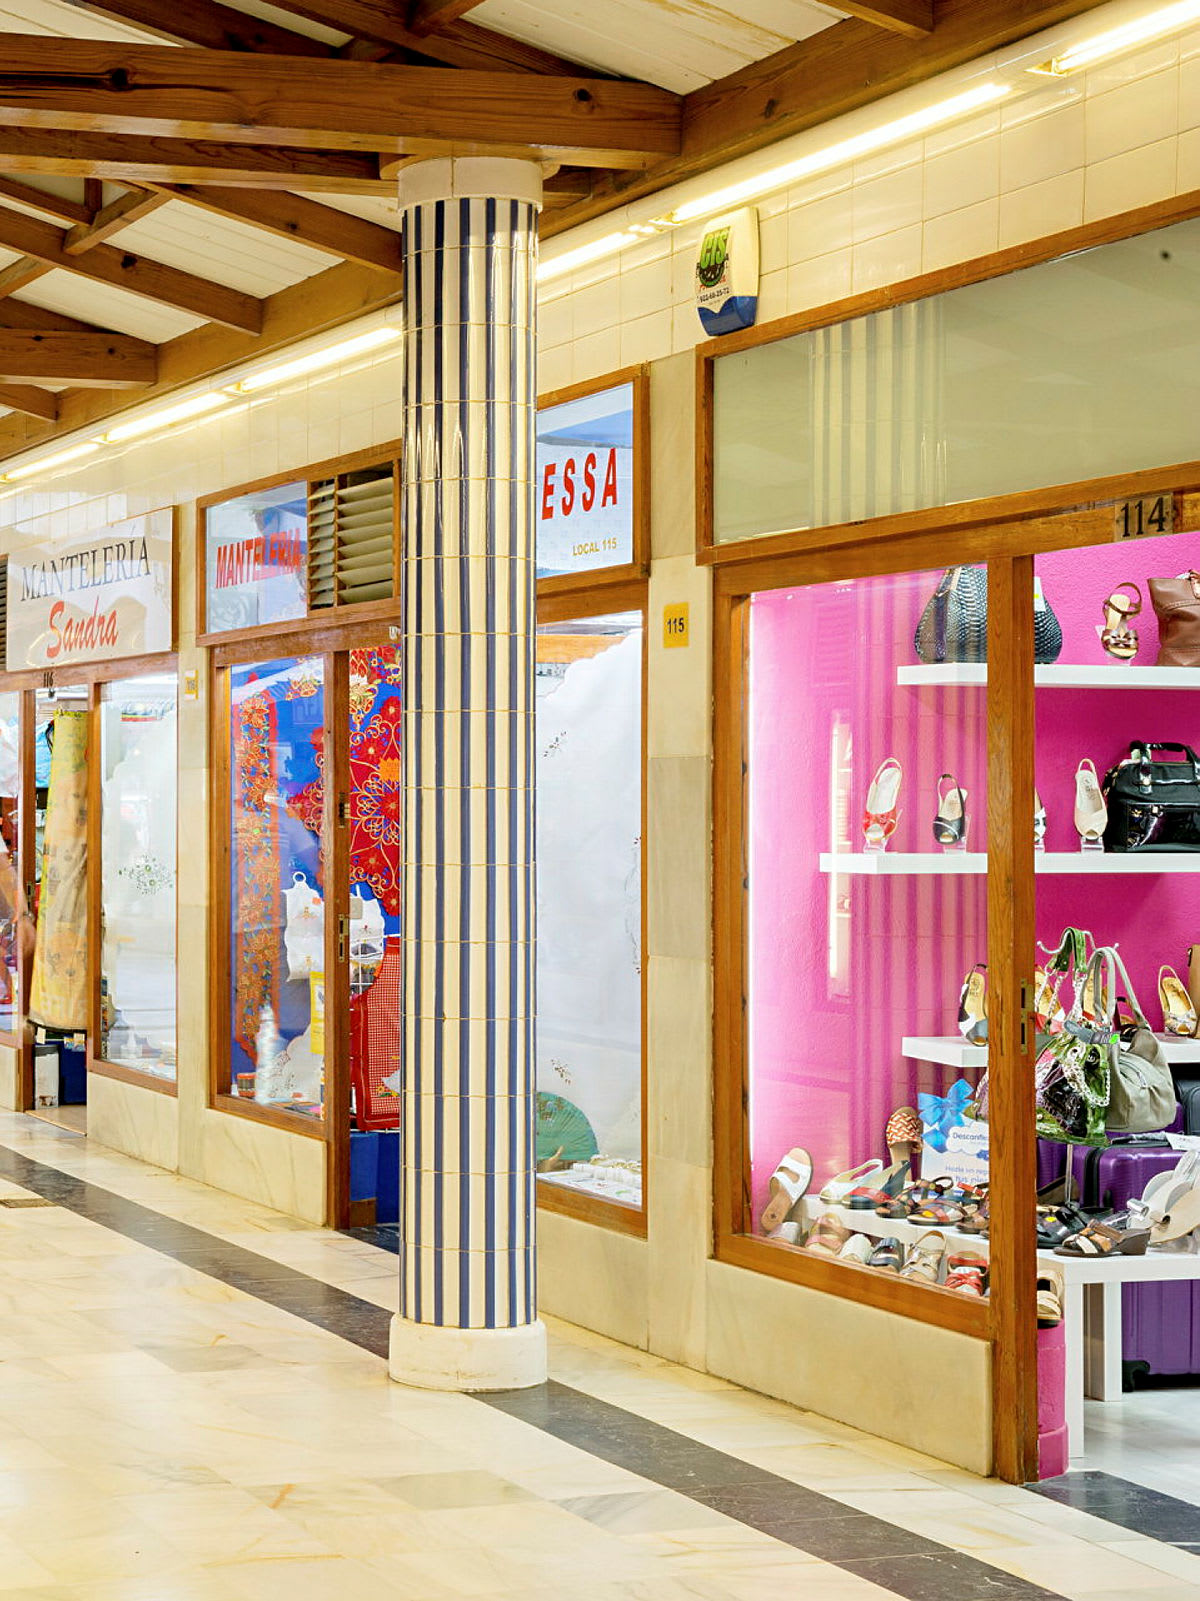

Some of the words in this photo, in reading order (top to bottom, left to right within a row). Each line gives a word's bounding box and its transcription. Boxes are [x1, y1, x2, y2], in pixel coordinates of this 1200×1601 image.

[542, 447, 618, 520] ESSA
[1120, 496, 1166, 538] 114
[572, 542, 601, 556] LOCAL
[602, 537, 618, 551] 115
[46, 594, 119, 659] Sandra
[666, 617, 685, 635] 115
[43, 671, 55, 689] 116
